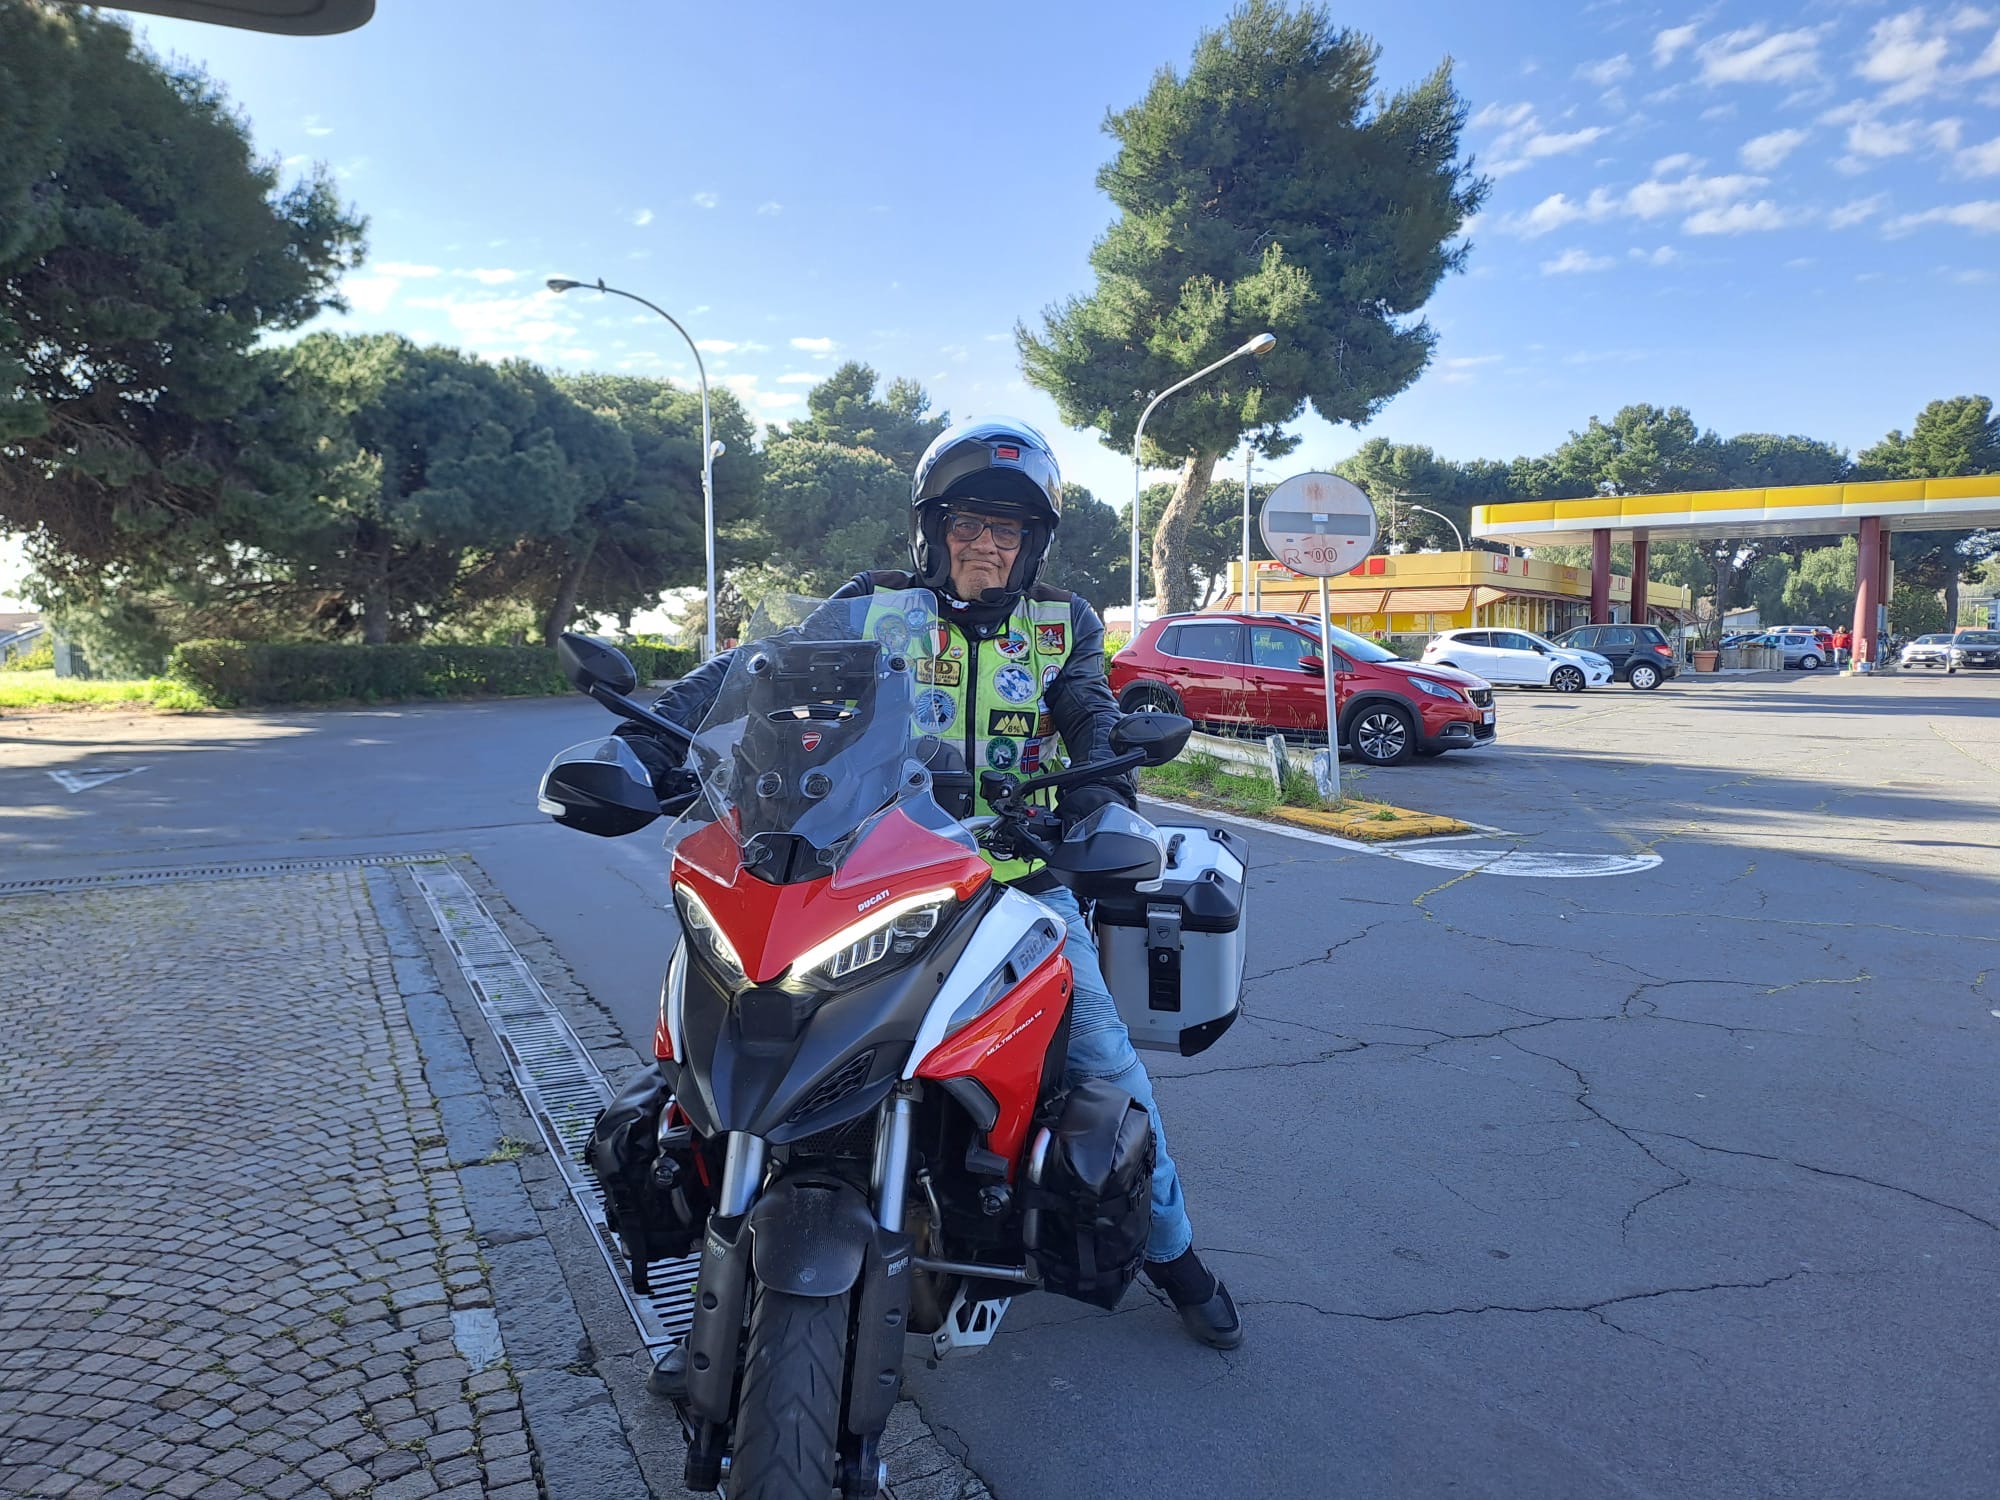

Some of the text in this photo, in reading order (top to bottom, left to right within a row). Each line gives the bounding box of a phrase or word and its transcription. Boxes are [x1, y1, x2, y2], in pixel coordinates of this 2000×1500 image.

[857, 889, 890, 913] DUCATI
[1018, 926, 1056, 970] DUCATI
[986, 1016, 1034, 1056] MULTISTRADA
[888, 1256, 909, 1271] DUCATI
